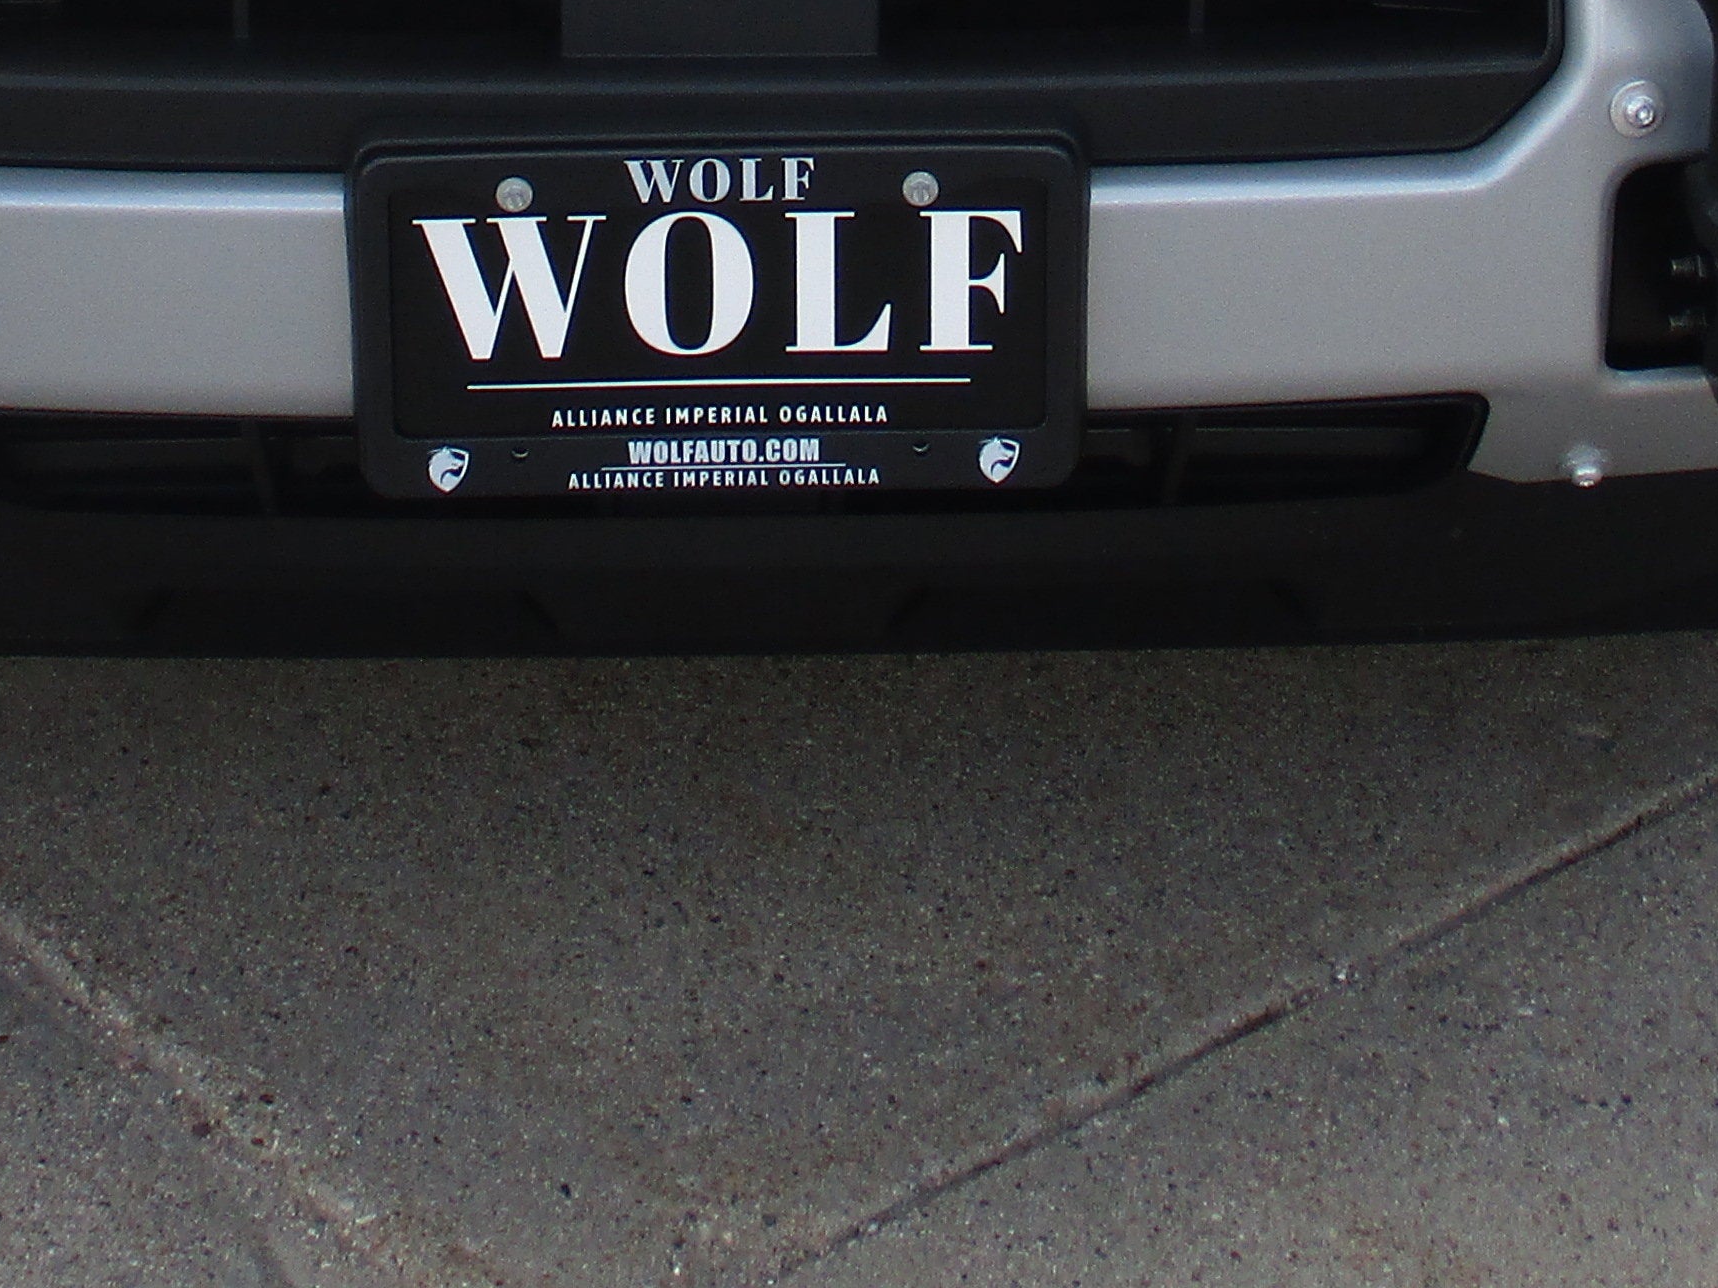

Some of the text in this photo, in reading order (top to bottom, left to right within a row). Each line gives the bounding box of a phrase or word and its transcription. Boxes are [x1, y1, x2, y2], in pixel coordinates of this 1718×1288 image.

[623, 157, 815, 204] WOLF
[412, 209, 1022, 360] WOLF
[551, 404, 888, 428] ALLIANCE IMPERIAL OGALLALA
[627, 438, 820, 464] WOLFAUTO.COM
[568, 468, 880, 490] ALLIANCE IMPERIAL OGALLALA
